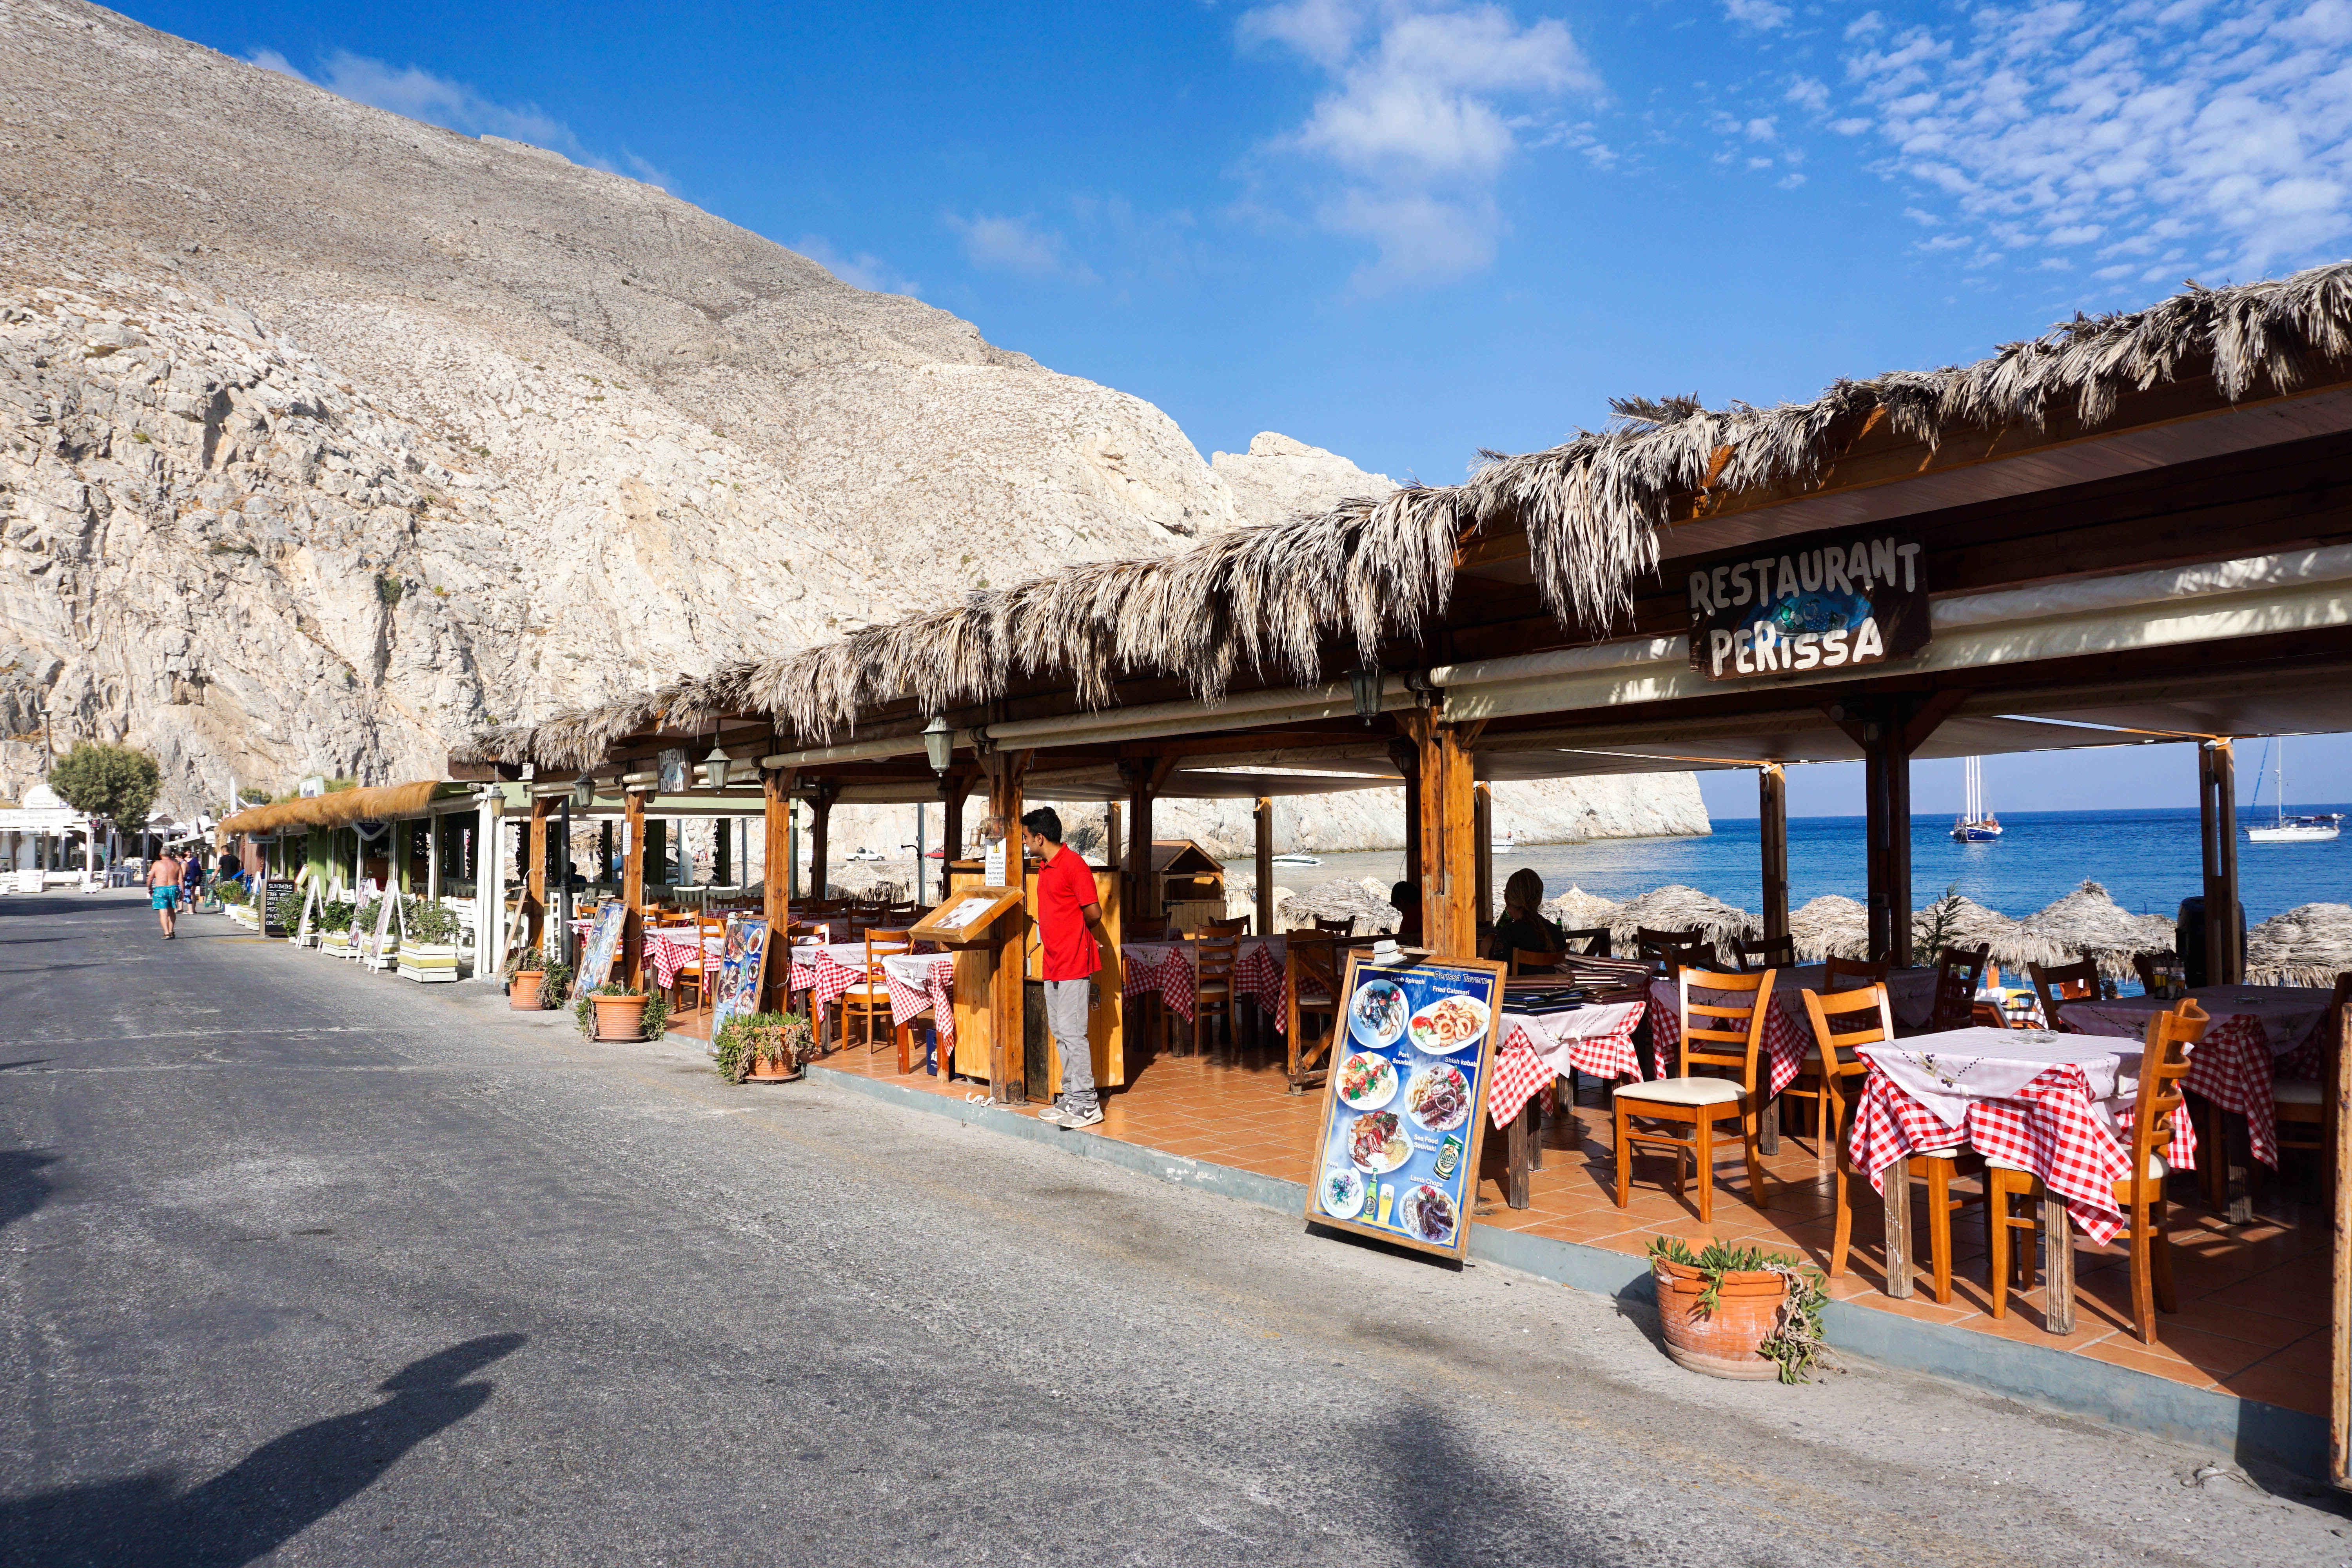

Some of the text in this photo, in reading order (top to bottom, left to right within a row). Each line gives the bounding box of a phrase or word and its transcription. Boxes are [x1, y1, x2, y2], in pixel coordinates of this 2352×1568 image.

[1689, 537, 1920, 621] RESTAURANT
[1434, 971, 1487, 984] Perissa Tavern
[1392, 1058, 1414, 1066] Souvlaki
[1425, 1136, 1438, 1145] Food
[1414, 1142, 1437, 1152] Souvlaki
[1410, 1174, 1425, 1183] Lamb
[1426, 1178, 1443, 1188] Chops
